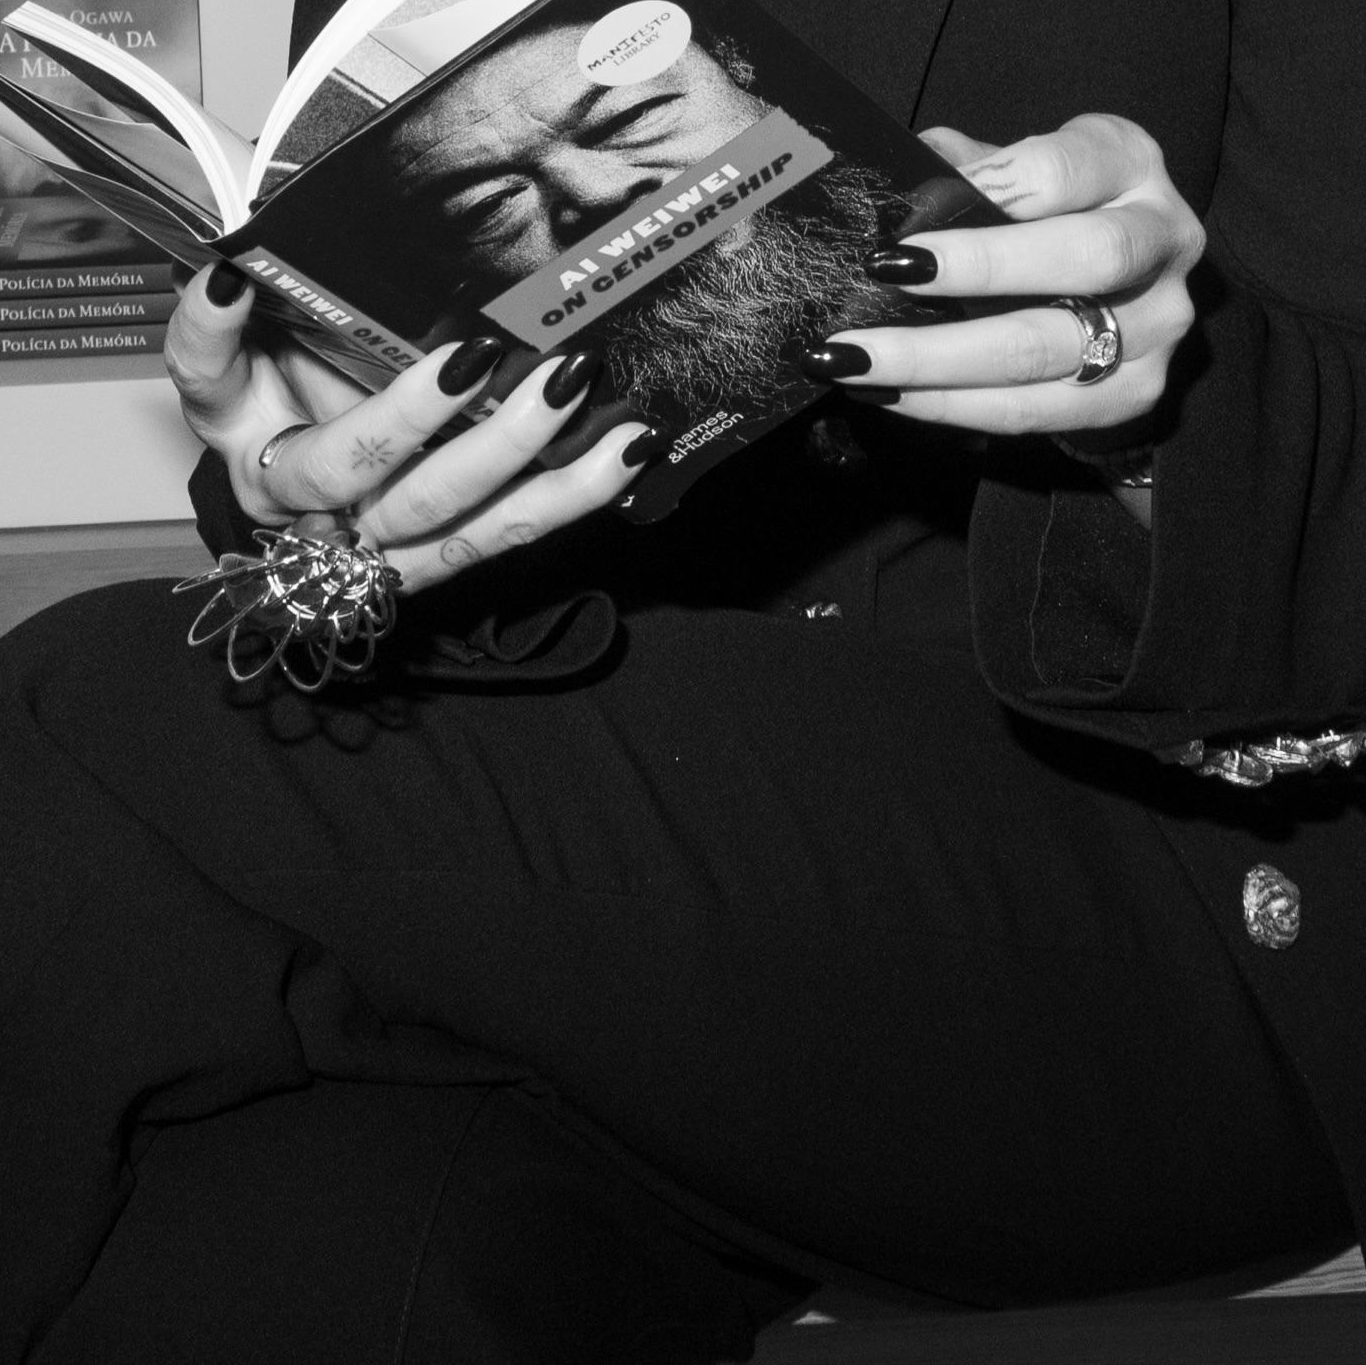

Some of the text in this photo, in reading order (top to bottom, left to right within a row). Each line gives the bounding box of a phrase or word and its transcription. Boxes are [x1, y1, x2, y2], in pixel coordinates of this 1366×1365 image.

[542, 152, 793, 327] ON CENSORSHIP
[558, 163, 741, 291] AI WEIWEI
[245, 259, 387, 346] AI WEIWEI ON
[668, 412, 744, 464] &Hudson
